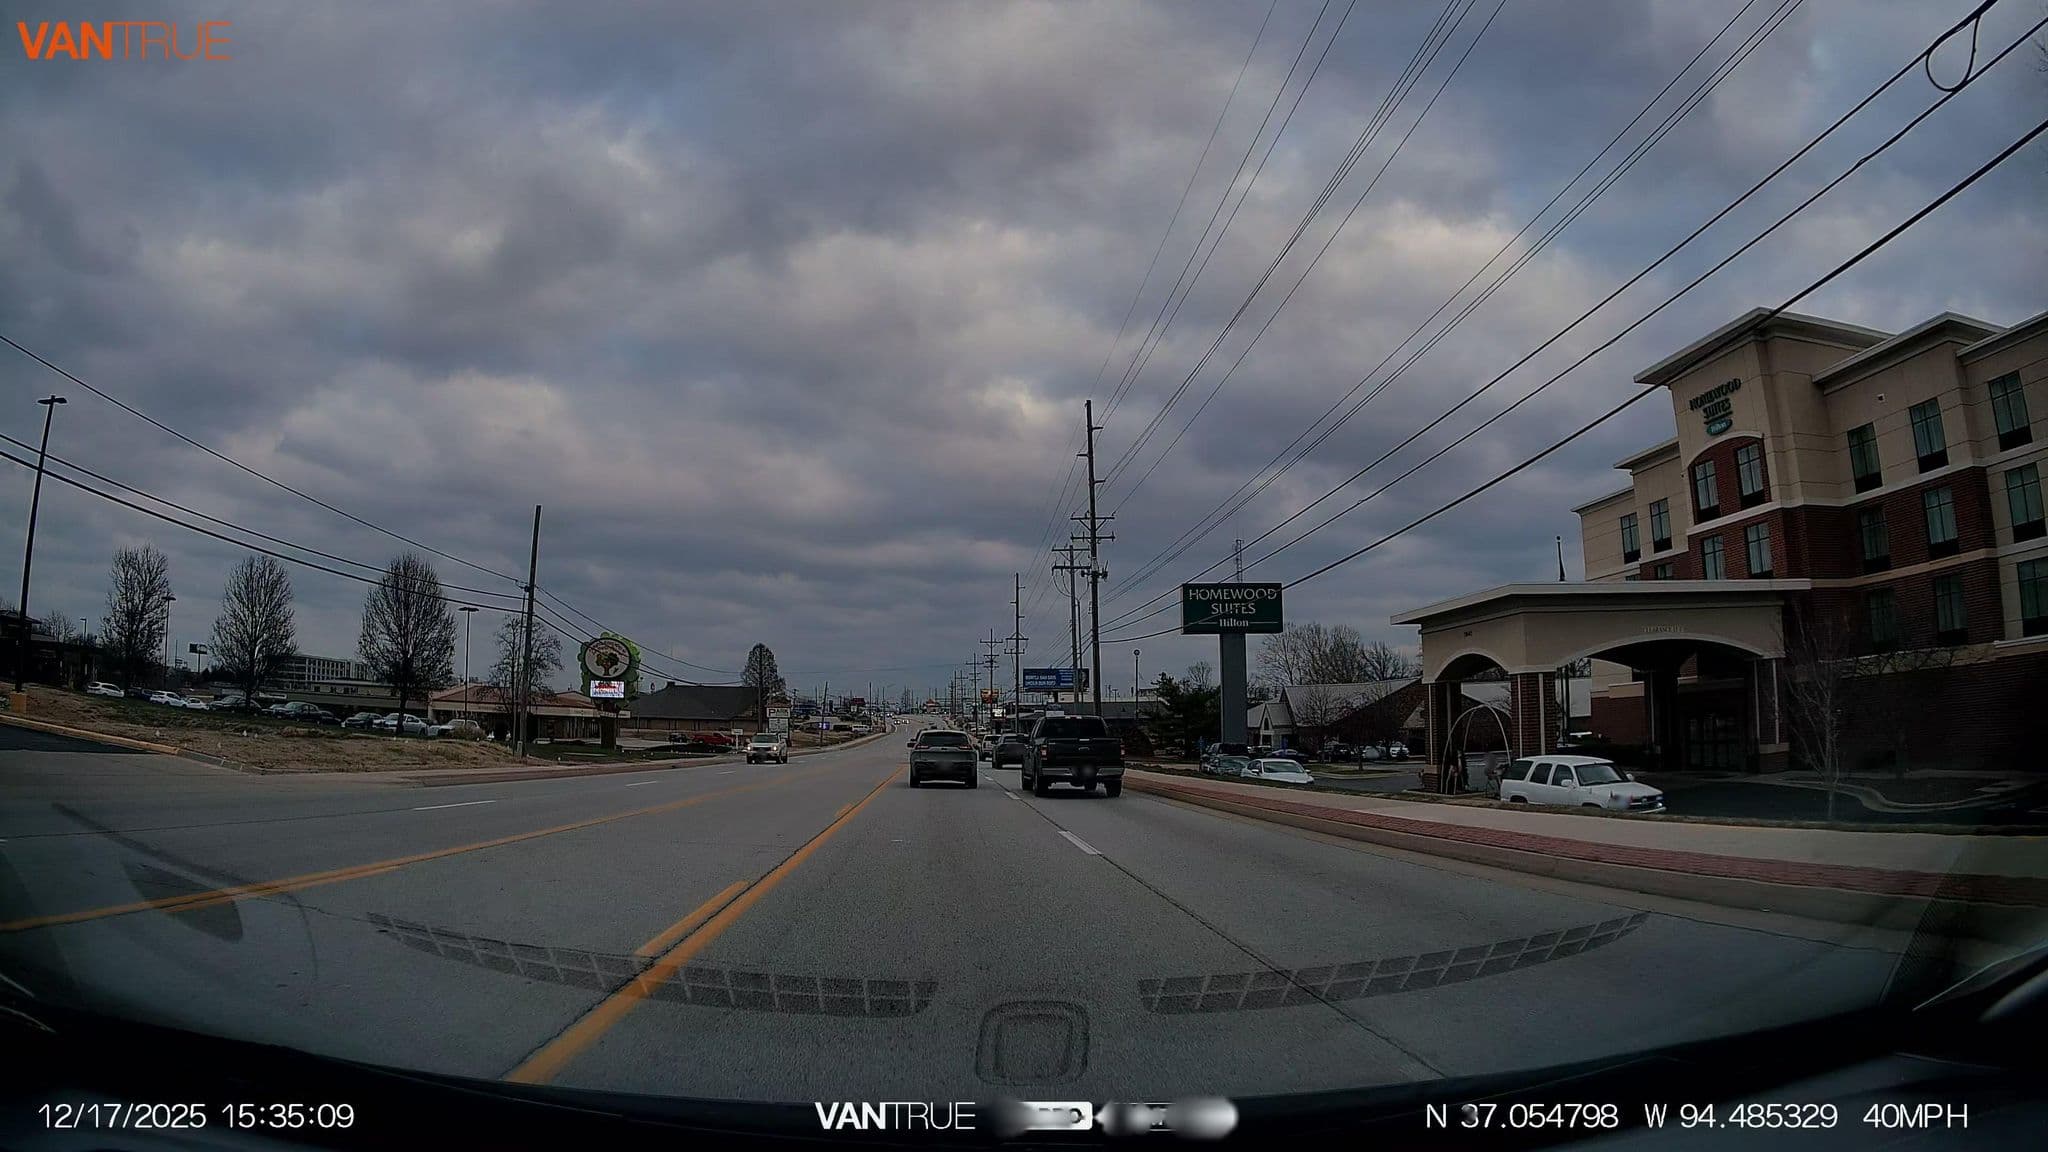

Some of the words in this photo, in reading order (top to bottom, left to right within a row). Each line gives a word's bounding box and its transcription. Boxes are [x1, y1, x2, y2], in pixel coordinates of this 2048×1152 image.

[1189, 588, 1277, 600] HOMEWOOD
[1211, 602, 1256, 614] SUITES
[1219, 618, 1249, 627] Hilton
